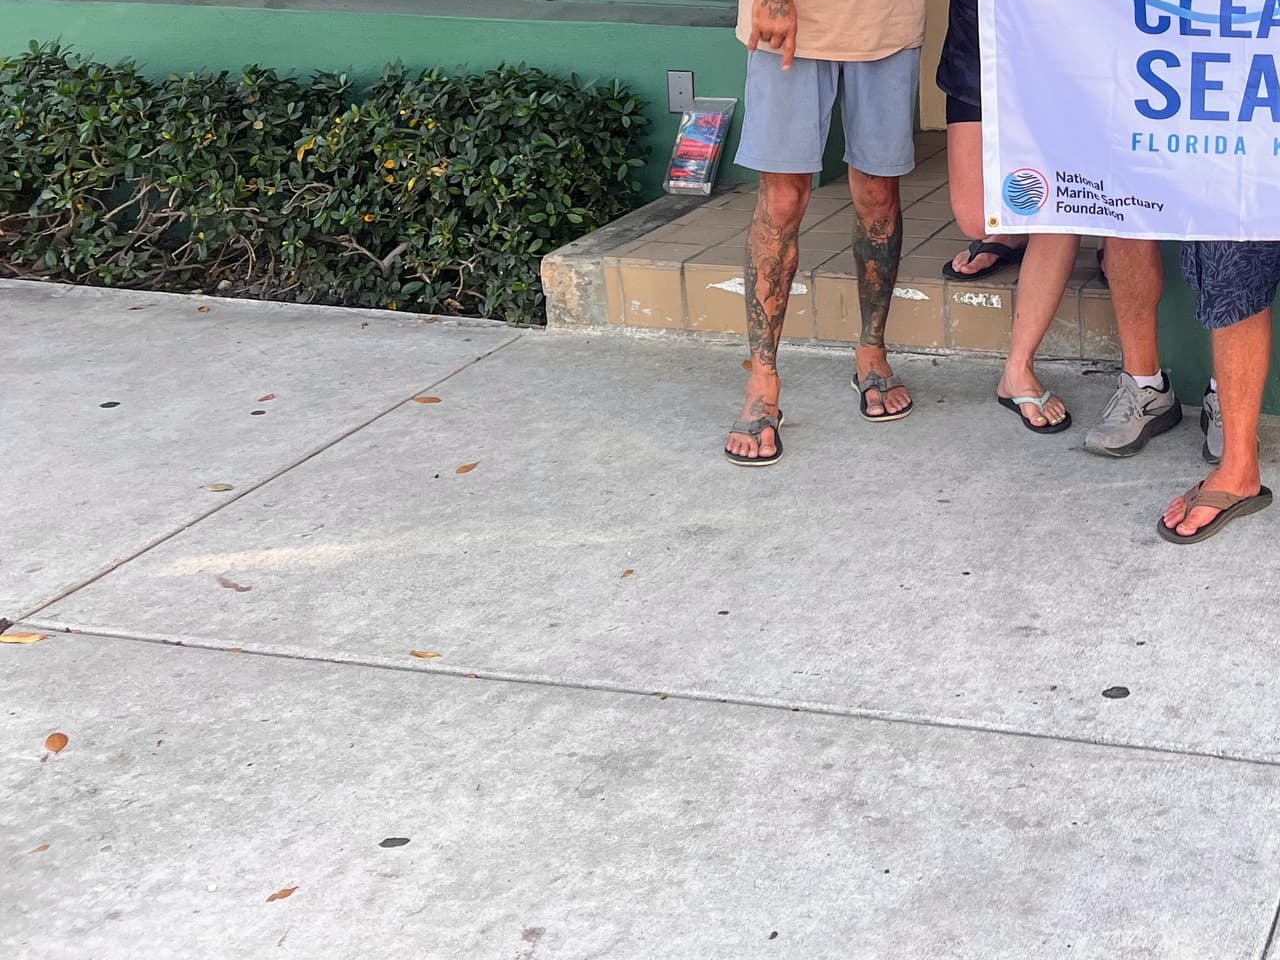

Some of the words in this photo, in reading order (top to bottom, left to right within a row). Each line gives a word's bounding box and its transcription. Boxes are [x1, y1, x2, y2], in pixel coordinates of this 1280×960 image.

[1131, 132, 1247, 155] FLORIDA
[1055, 171, 1104, 191] National
[1055, 185, 1100, 201] Marine
[1100, 194, 1164, 212] Sanctuary
[1055, 201, 1125, 221] Foundation
